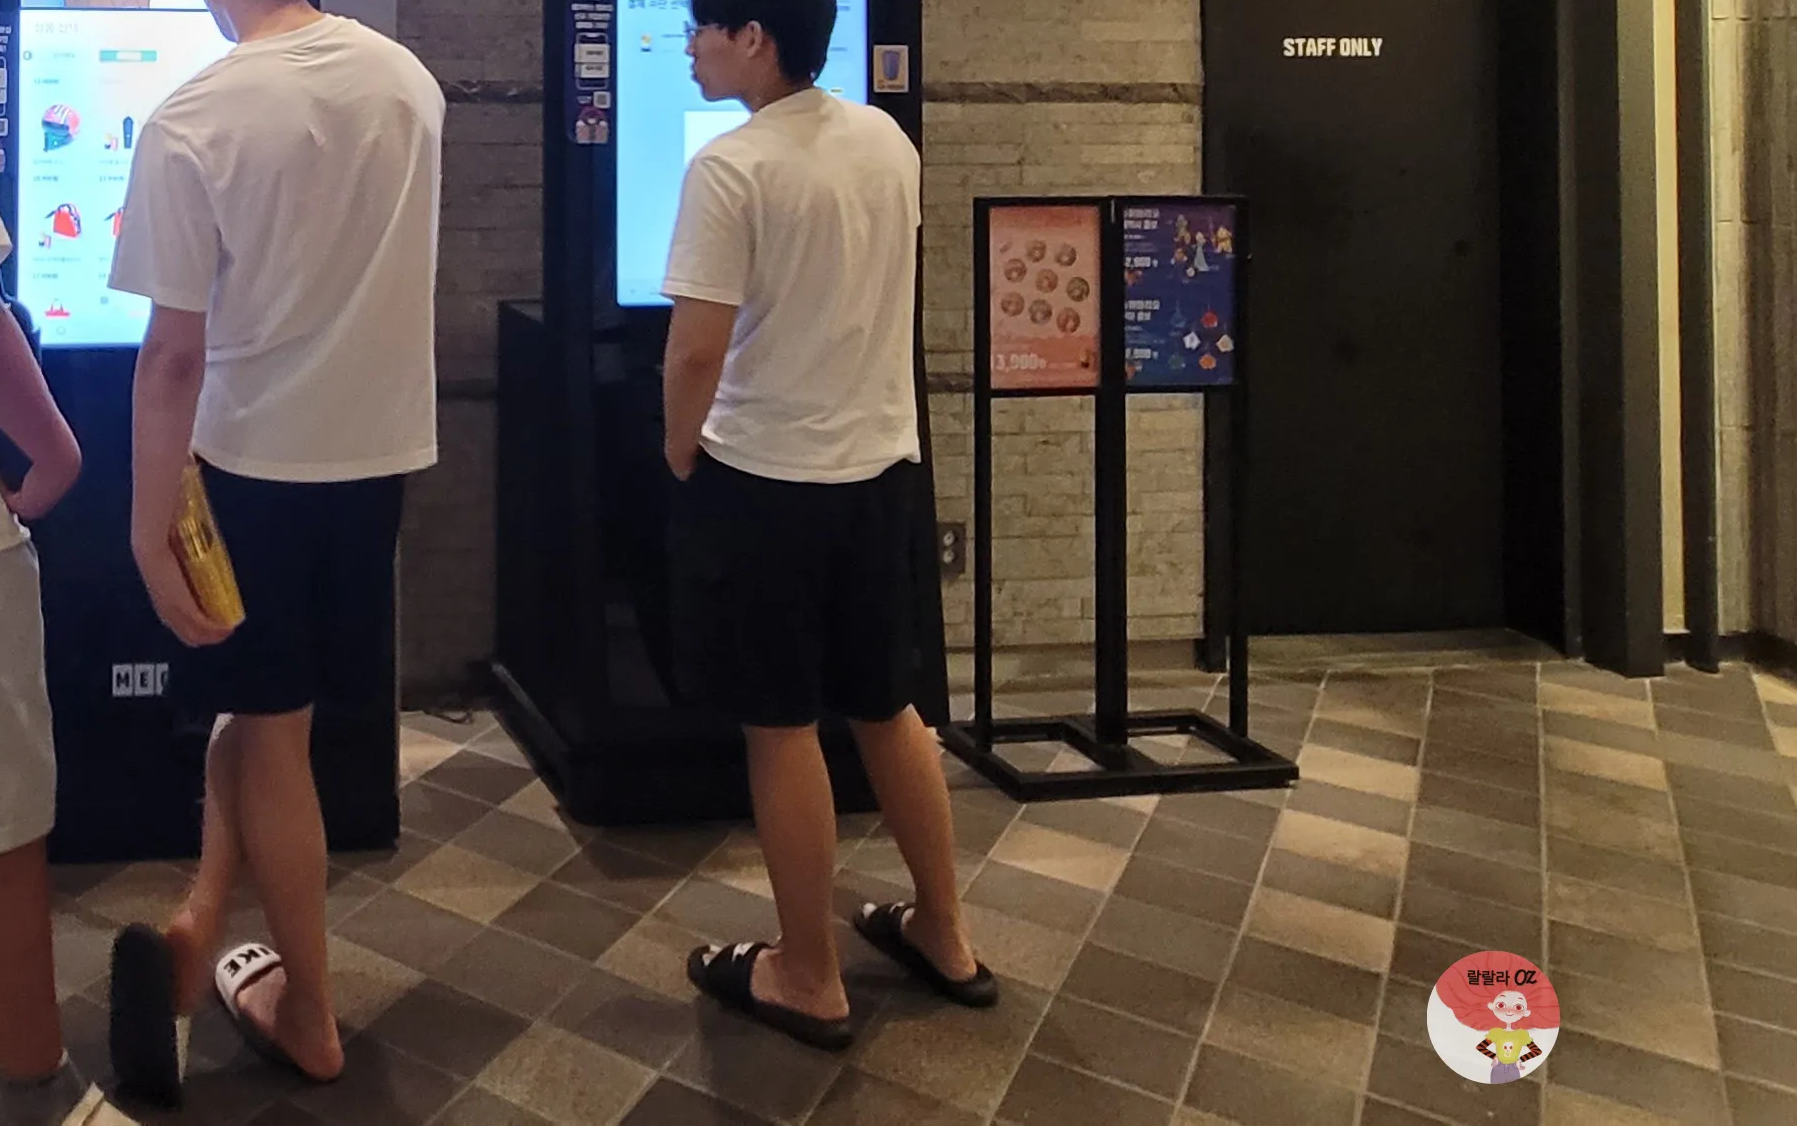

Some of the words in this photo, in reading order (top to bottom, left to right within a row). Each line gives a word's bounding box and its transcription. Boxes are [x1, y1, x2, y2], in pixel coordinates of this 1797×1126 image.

[1283, 37, 1336, 57] STAFF
[1339, 37, 1383, 57] ONLY
[223, 947, 270, 978] IKE
